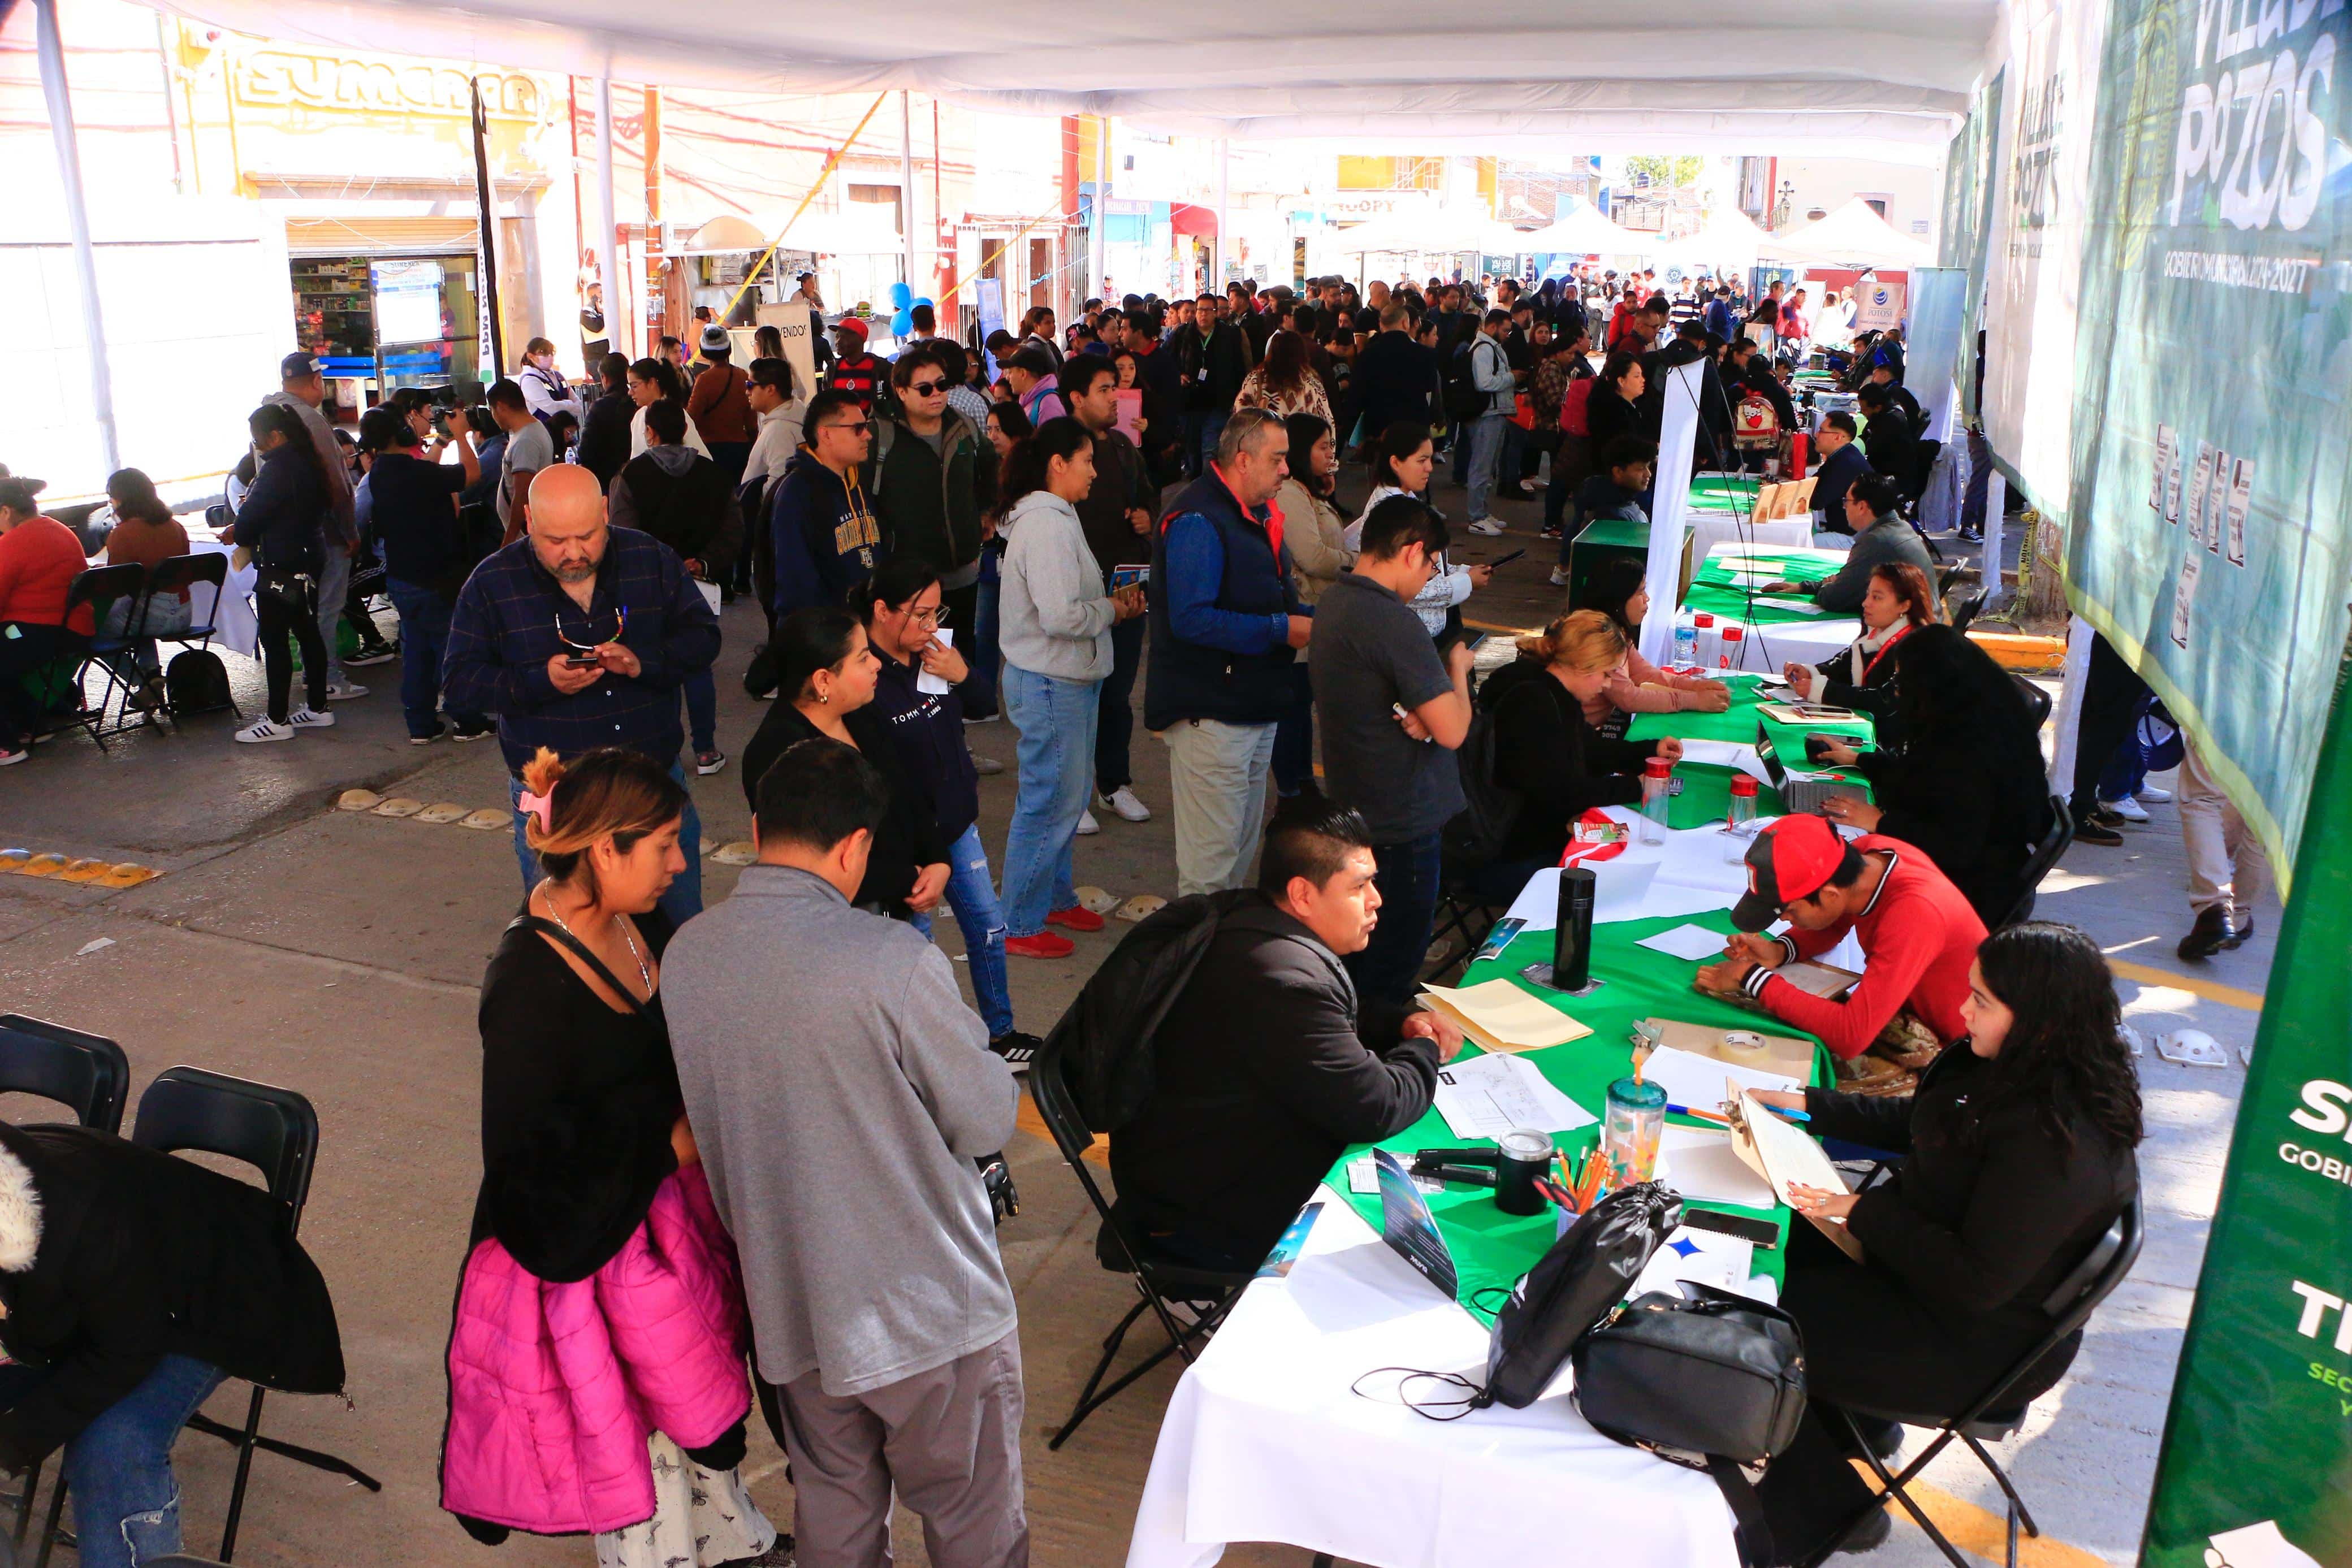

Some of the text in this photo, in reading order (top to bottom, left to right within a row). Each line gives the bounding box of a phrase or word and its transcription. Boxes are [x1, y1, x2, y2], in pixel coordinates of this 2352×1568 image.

[2171, 33, 2336, 232] POZOS
[892, 707, 920, 724] TOMM
[2289, 1079, 2352, 1145] S
[2278, 1142, 2352, 1187] GOBI
